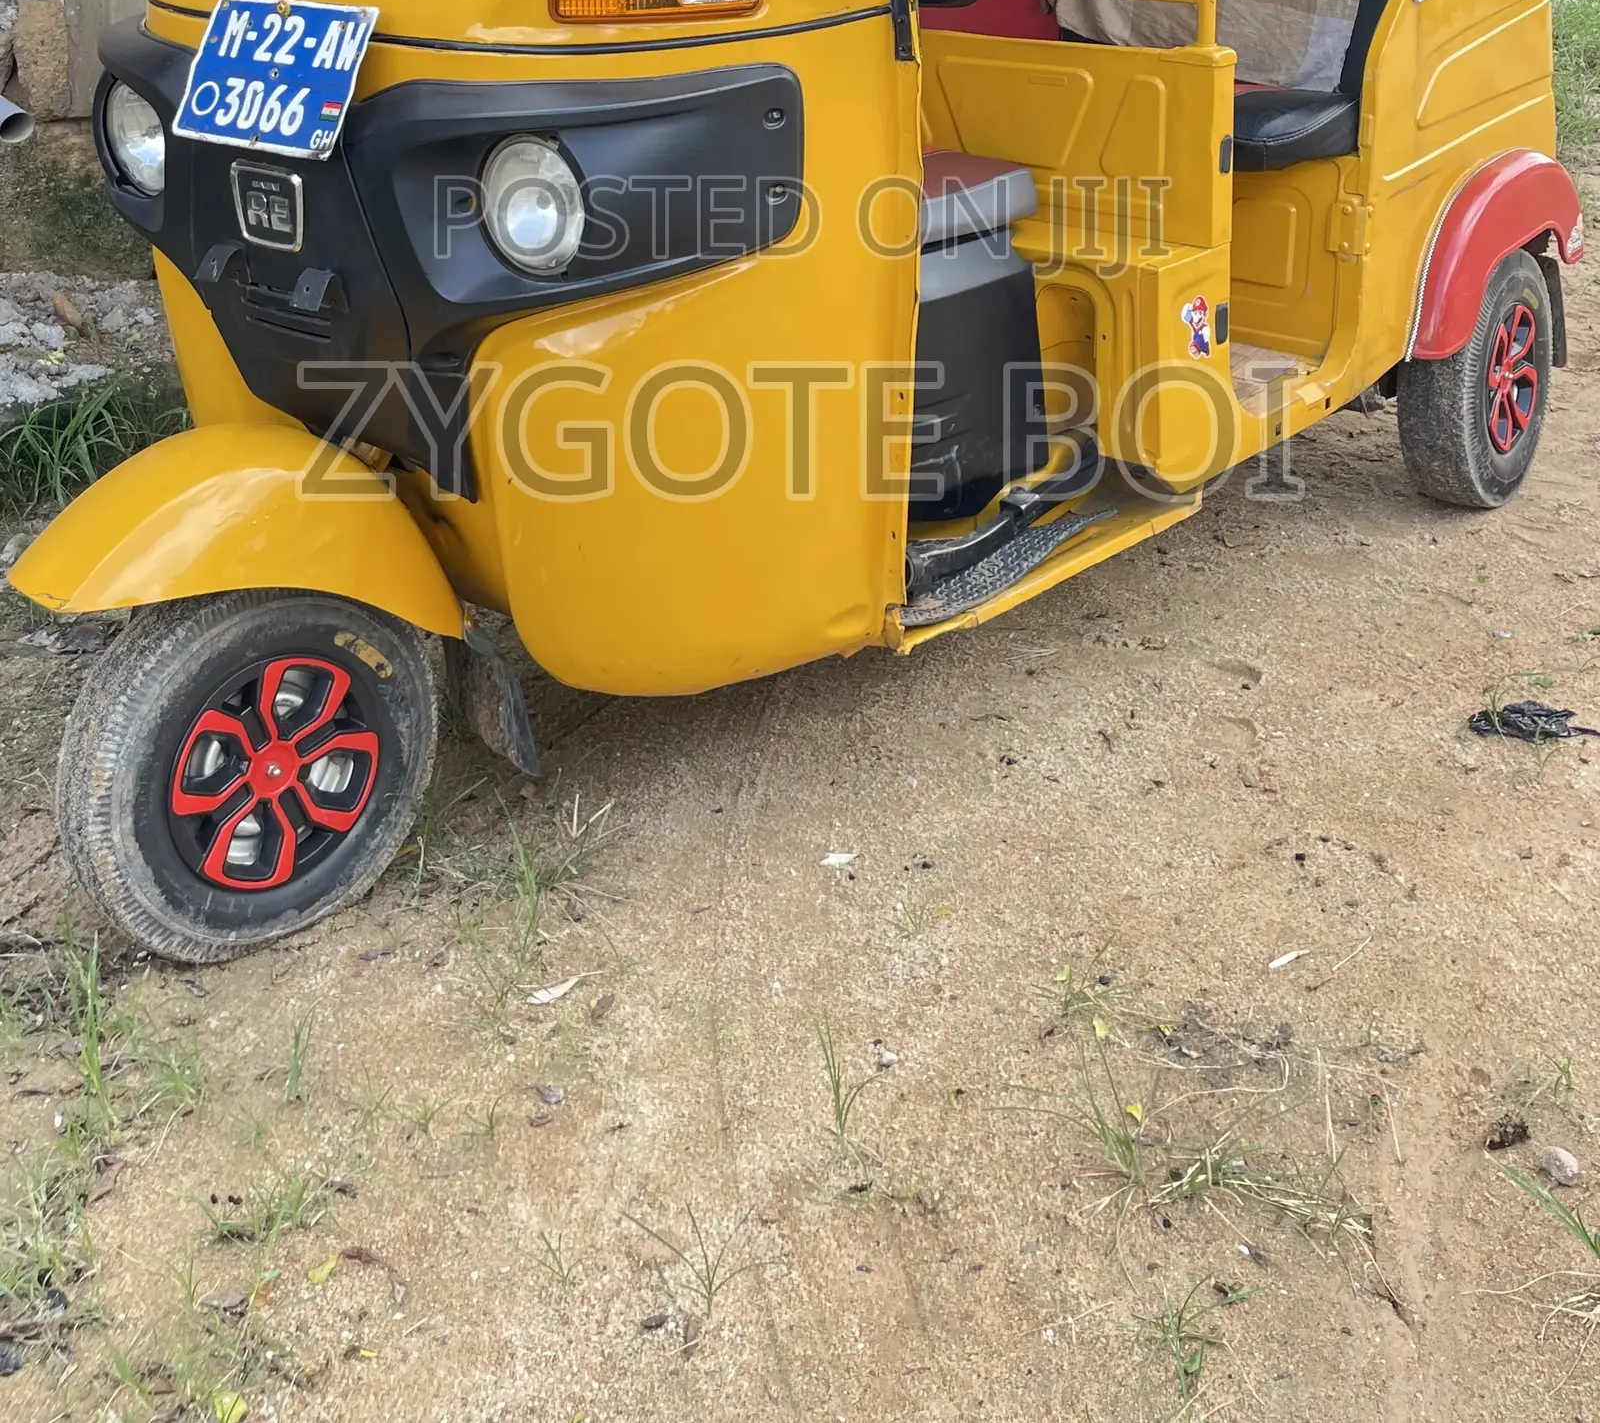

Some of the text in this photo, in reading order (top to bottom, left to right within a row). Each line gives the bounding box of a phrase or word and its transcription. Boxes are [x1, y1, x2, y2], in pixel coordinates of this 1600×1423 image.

[218, 9, 367, 71] M-22-AW
[215, 77, 311, 137] 3066
[309, 129, 334, 150] GH
[246, 190, 293, 233] RE
